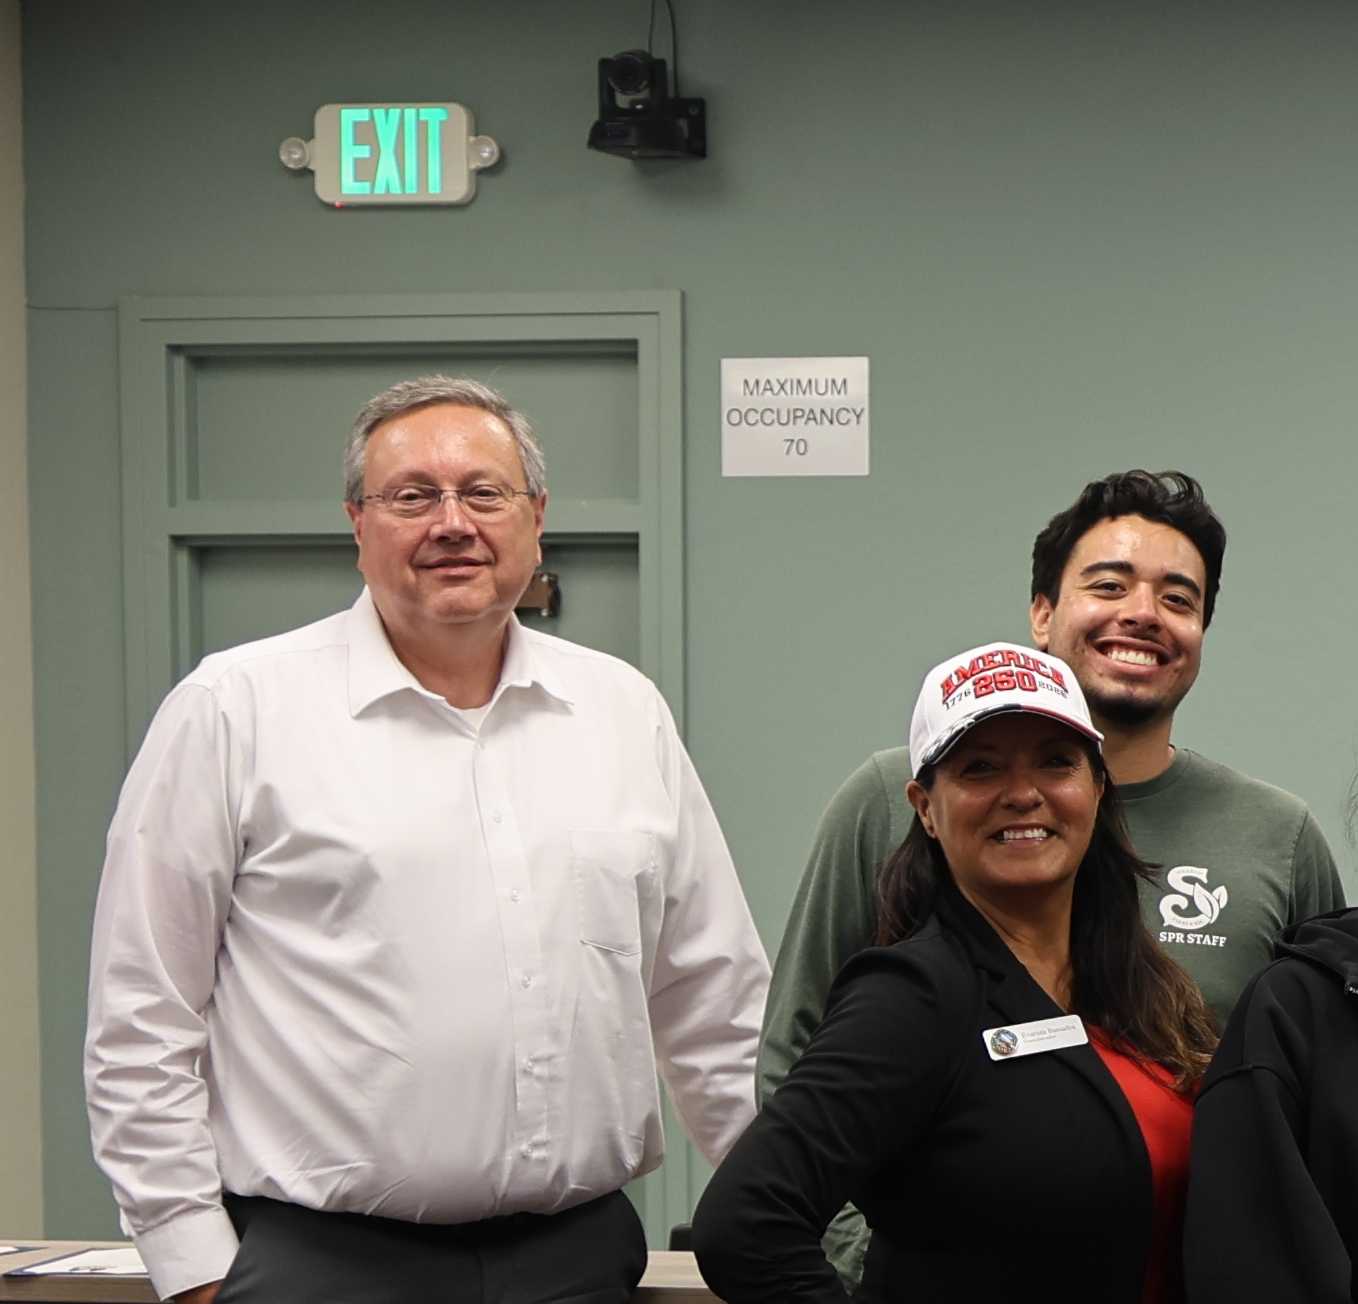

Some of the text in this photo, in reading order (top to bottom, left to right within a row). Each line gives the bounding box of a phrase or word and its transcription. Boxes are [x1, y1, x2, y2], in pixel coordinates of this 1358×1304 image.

[339, 107, 448, 195] EXIT
[742, 377, 849, 397] MAXIMUM
[726, 406, 865, 427] OCCUPANCY
[783, 438, 808, 457] 70
[940, 649, 1069, 704] AMERICA
[943, 688, 971, 711] 1776
[1159, 931, 1227, 947] SPR STAFF
